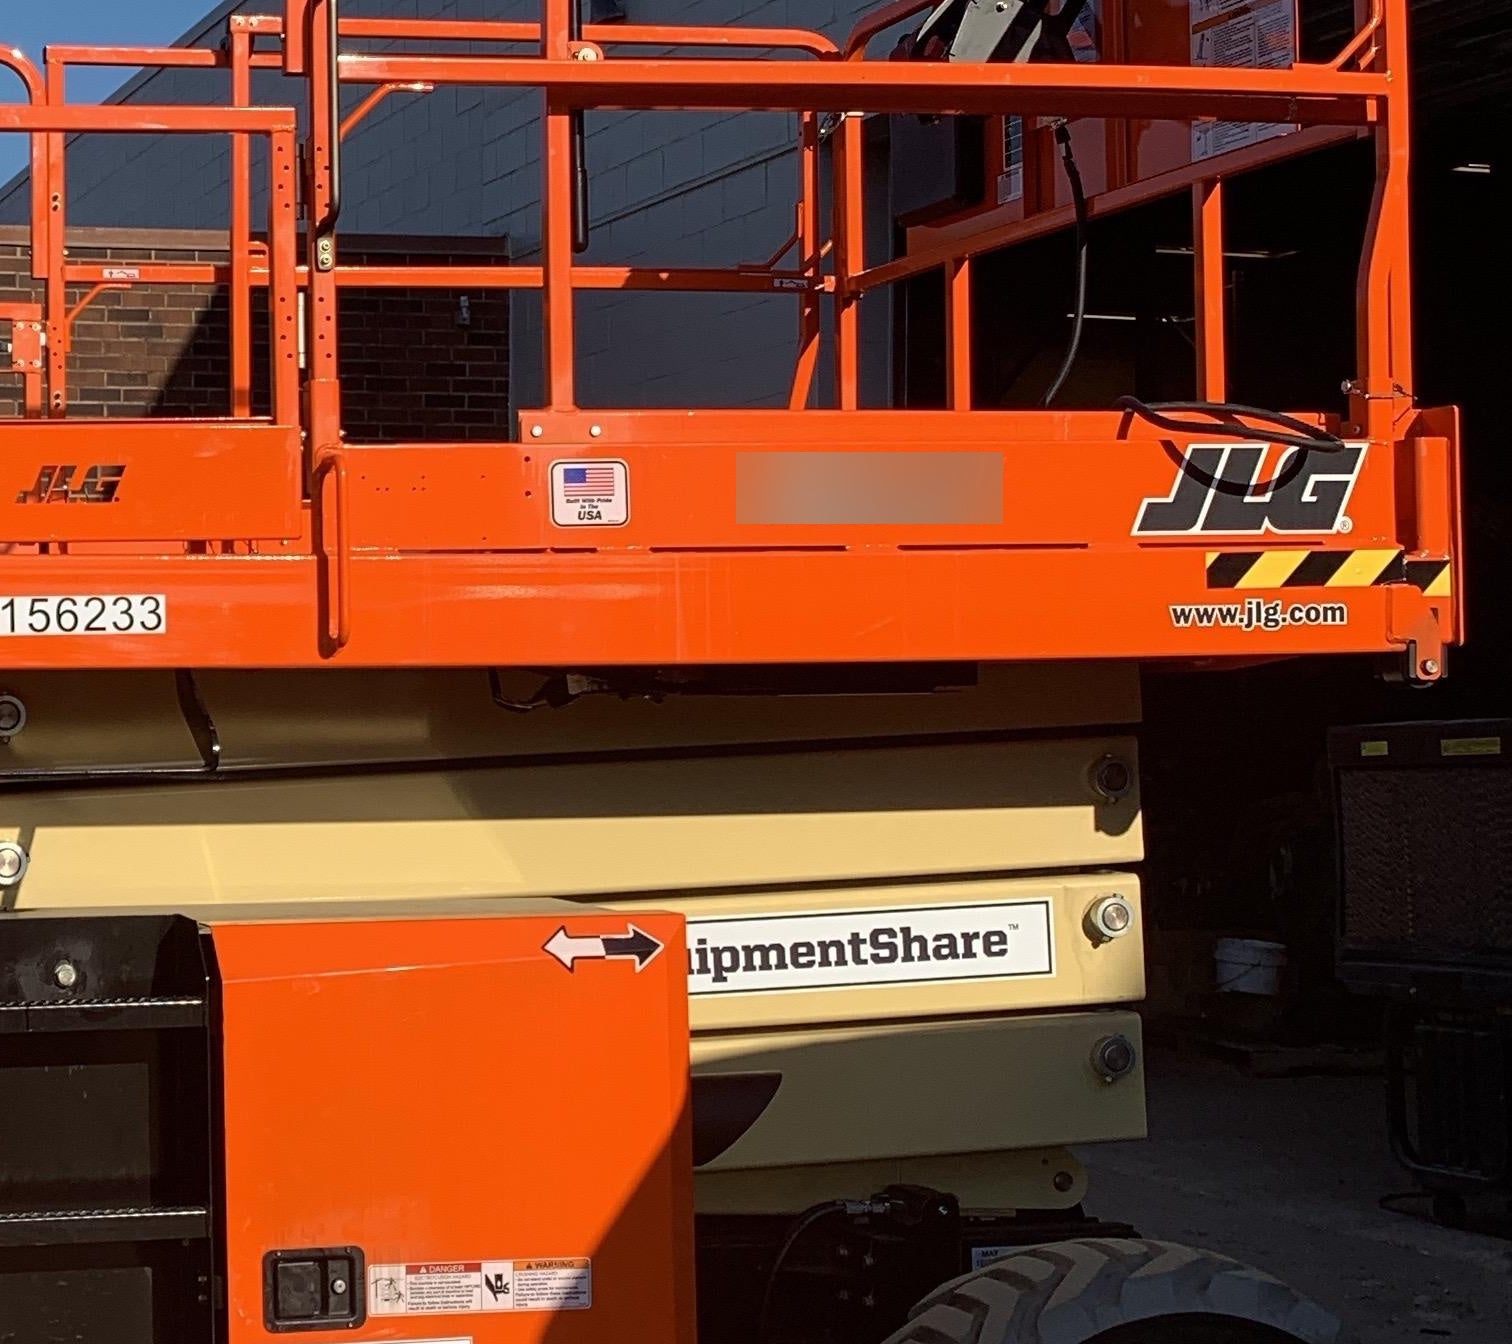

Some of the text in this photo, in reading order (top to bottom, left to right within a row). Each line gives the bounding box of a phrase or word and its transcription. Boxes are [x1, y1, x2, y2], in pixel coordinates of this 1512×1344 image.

[1131, 443, 1368, 536] JLG
[578, 510, 602, 520] USA
[1, 596, 162, 633] 156233
[1171, 600, 1347, 629] www.jlg.com
[428, 1264, 465, 1274] DANGER
[534, 1260, 575, 1269] WARNING
